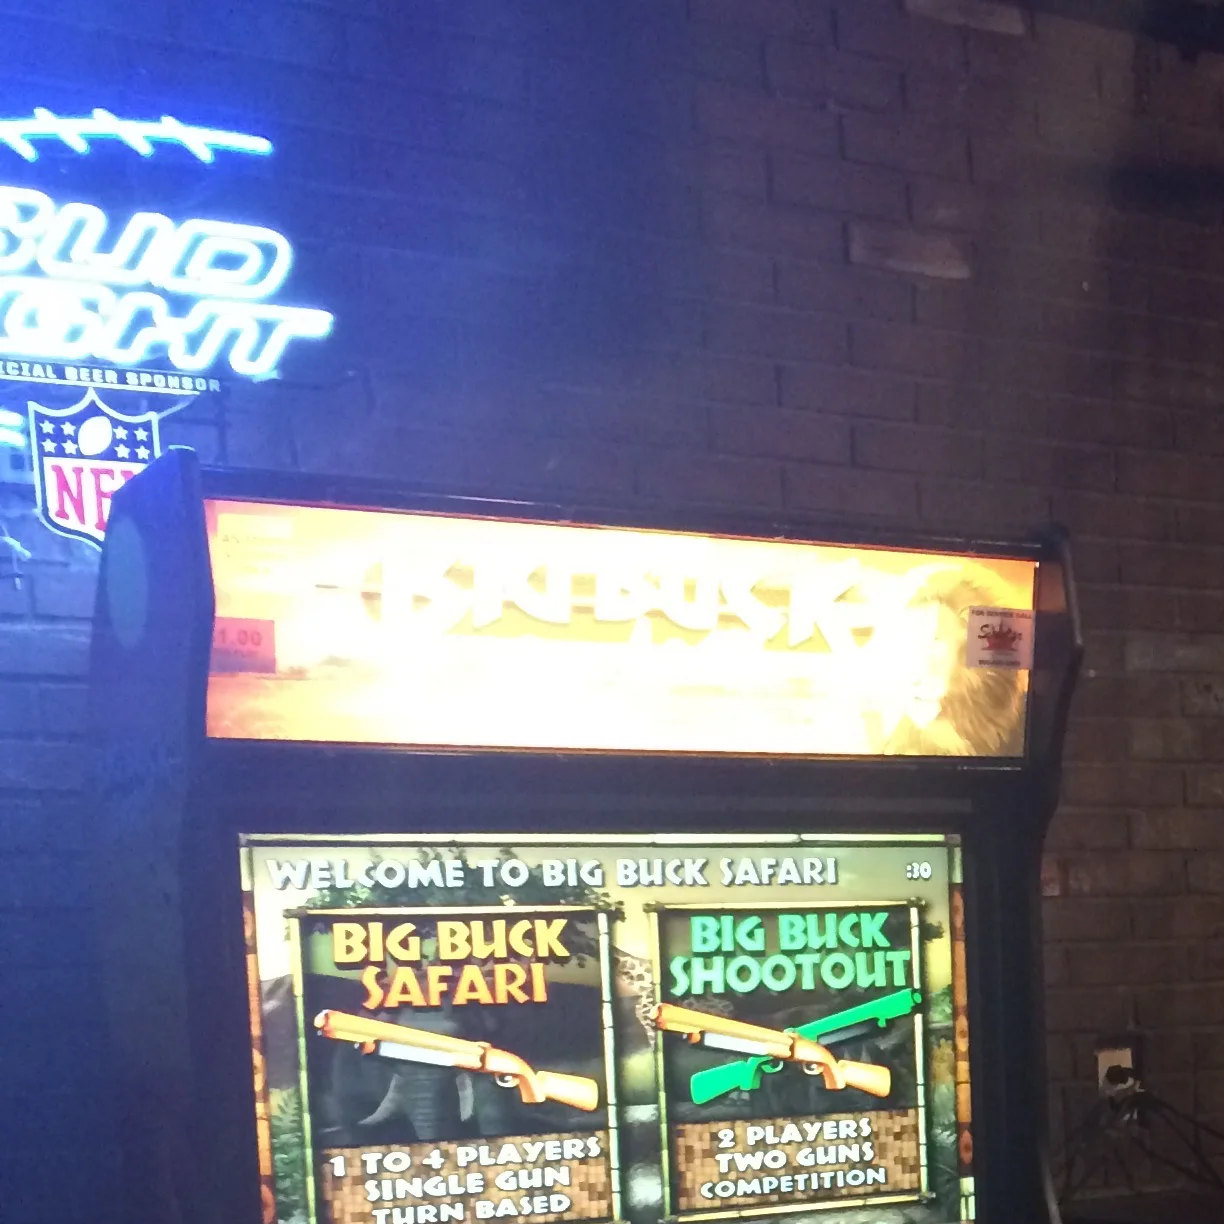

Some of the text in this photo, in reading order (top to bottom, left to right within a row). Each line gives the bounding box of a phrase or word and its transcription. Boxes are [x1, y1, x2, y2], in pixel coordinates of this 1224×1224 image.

[65, 365, 119, 385] BEER
[125, 371, 221, 393] SPONSOR
[51, 464, 135, 532] NF
[266, 856, 839, 890] WELCOME TO BIG BUCK SAFARI
[905, 861, 933, 880] :30
[332, 918, 571, 966] BIG BUCK
[690, 912, 890, 953] BIG BUCK
[360, 962, 549, 1010] SAFARI
[669, 951, 911, 997] SHOOTOUT
[717, 1118, 873, 1149] 2 PLAYERS
[329, 1136, 601, 1177] 1 TO 4 PLAYERS
[716, 1142, 875, 1174] TWO GUNS
[364, 1166, 570, 1202] SINGLE GUN
[700, 1168, 886, 1199] COMPETITION
[475, 1195, 571, 1220] BASED
